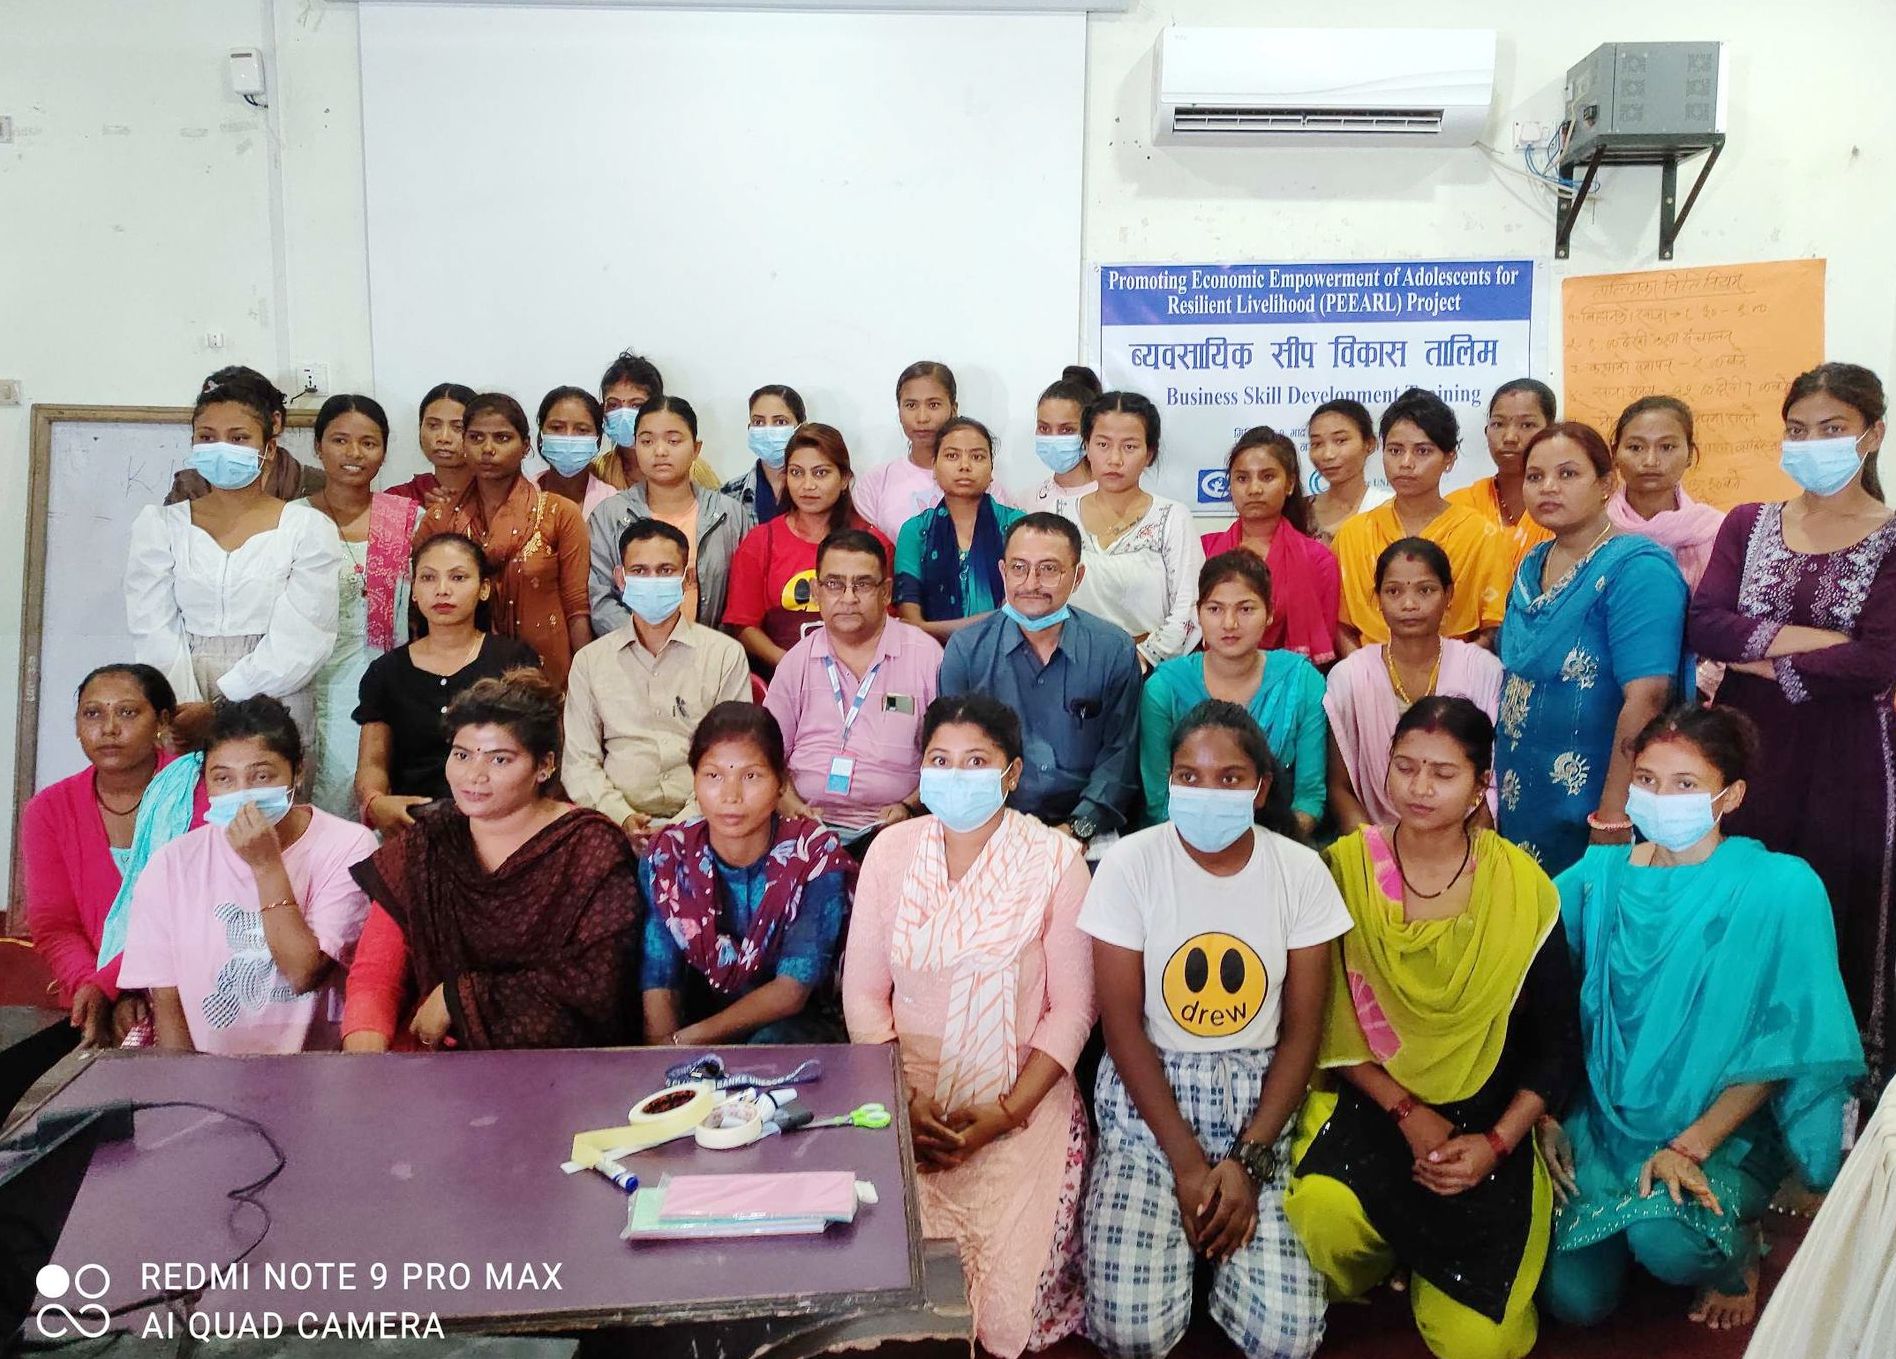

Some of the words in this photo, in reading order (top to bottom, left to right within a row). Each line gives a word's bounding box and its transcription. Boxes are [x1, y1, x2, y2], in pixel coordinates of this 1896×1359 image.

[1108, 270, 1187, 294] Promoting
[1192, 270, 1264, 290] Economic
[1269, 269, 1379, 291] Empowerment
[1384, 268, 1400, 287] of
[1402, 267, 1490, 287] Adolescents
[1495, 268, 1518, 285] for
[1168, 297, 1232, 315] Resilient
[1237, 294, 1314, 313] Livelihood
[1320, 293, 1402, 318] (PEEARL)
[1407, 292, 1460, 315] Project
[1129, 337, 1254, 370] व्यवसायिक
[1270, 336, 1317, 369] सीप
[1329, 336, 1408, 368] विकास
[1425, 334, 1499, 366] तालिम
[1167, 387, 1238, 406] Business
[1243, 387, 1282, 405] Skill
[1180, 1000, 1248, 1026] drew
